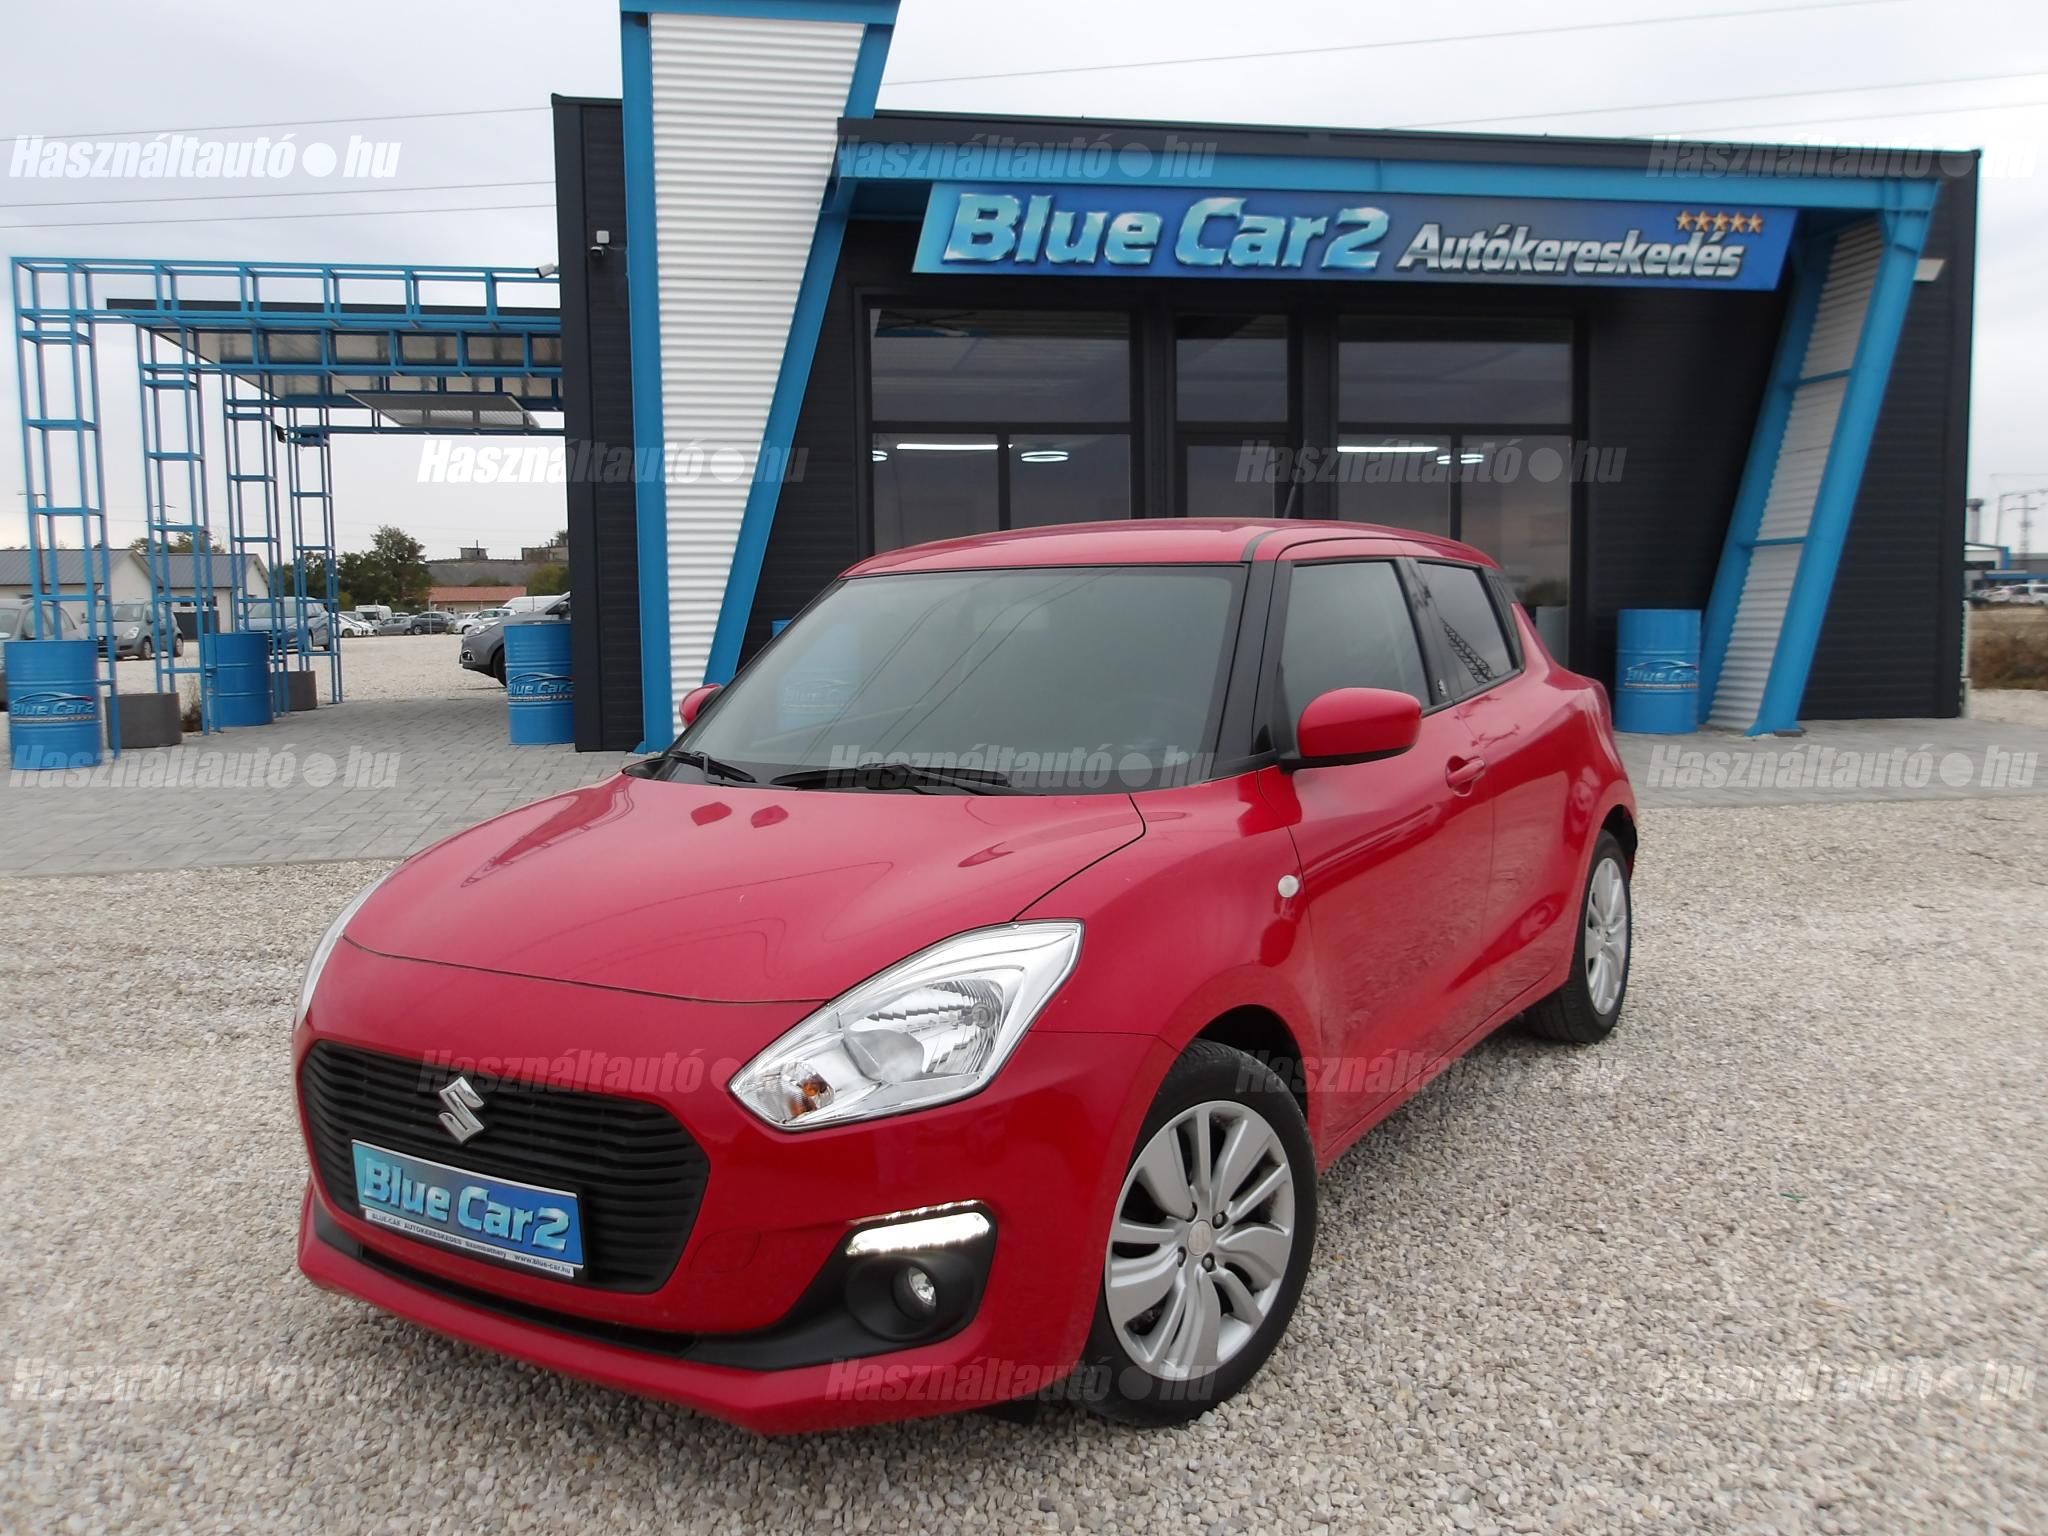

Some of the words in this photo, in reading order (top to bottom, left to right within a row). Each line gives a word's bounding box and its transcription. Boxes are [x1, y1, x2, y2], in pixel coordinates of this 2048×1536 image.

[941, 191, 1164, 266] Blue
[1396, 222, 1746, 280] Autókereskedés
[10, 701, 49, 715] Blue
[363, 1157, 451, 1223] Blue
